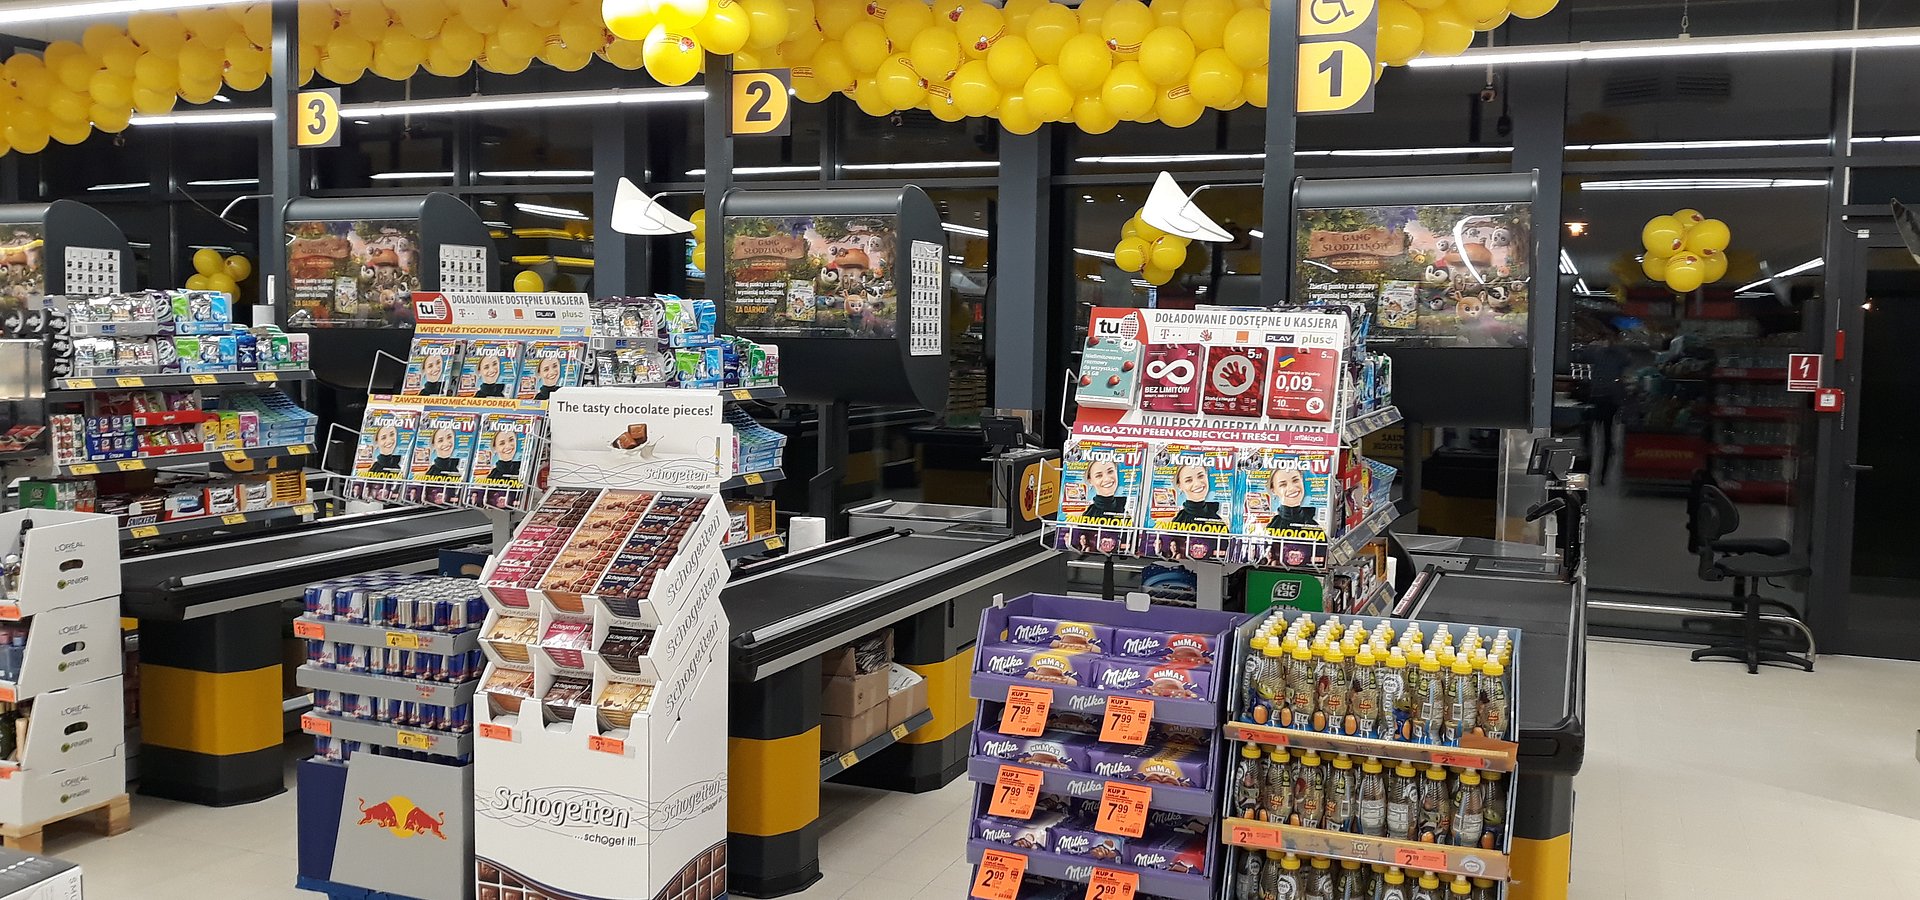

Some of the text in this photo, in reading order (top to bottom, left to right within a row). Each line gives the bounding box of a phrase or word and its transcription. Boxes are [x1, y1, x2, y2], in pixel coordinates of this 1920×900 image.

[1318, 49, 1342, 97] 1
[744, 80, 772, 122] 2
[307, 98, 326, 136] 3
[1342, 233, 1371, 242] GANG
[1322, 240, 1388, 252] SŁODZIAKÓW
[418, 302, 434, 315] tu
[452, 295, 585, 308] DOŁADOWANIE DOSTĘPNE U KASJERA
[562, 309, 577, 319] plus
[1155, 312, 1338, 329] DOŁADOWANIE DOSTĘPNE U KASJERA
[420, 326, 449, 335] WIĘCEJ
[449, 326, 460, 334] NIŻ
[460, 327, 502, 335] TYGODNIK
[503, 328, 555, 336] TELEWIZYJNY
[1098, 319, 1120, 334] tu
[1302, 334, 1325, 345] plus
[420, 345, 448, 356] Kropka
[476, 346, 505, 358] Kropka
[536, 348, 566, 360] Kropka
[1160, 386, 1190, 394] LIMITÓW
[1276, 374, 1312, 392] 0,09
[394, 396, 423, 404] ZAWSZE
[422, 397, 448, 406] WARTO
[448, 396, 466, 406] MIEĆ
[466, 398, 481, 406] NAS
[481, 399, 498, 407] POD
[557, 401, 714, 418] The tasty chocolate pieces!
[374, 417, 416, 428] Kropka TV
[430, 418, 474, 431] Kropka TV
[490, 420, 523, 434] Kropka
[1082, 424, 1280, 442] MAGAZYN PEŁEN KOBIECYCH TREŚCI
[1083, 450, 1142, 465] Kropka TV
[1171, 454, 1232, 468] Kropka TV
[1263, 456, 1330, 472] Kropka TV
[644, 468, 709, 484] Schogetten
[128, 516, 156, 526] SNICKERS
[1277, 590, 1296, 598] tac
[1281, 582, 1296, 591] tic
[550, 622, 581, 632] Schogetten
[1015, 624, 1050, 643] Milka
[1123, 638, 1160, 658] Milka
[988, 654, 1024, 675] Milka
[1102, 668, 1140, 690] Milka
[1069, 694, 1106, 712] Milka
[983, 740, 1018, 756] Milka
[1095, 761, 1133, 777] Milka
[1067, 780, 1104, 796] Milka
[490, 786, 630, 829] Schogetten
[662, 779, 722, 824] Schogetten
[1152, 812, 1182, 824] Milka
[982, 828, 1012, 844] Milka
[1058, 835, 1090, 852] Milka
[1352, 841, 1369, 850] TOY
[1134, 852, 1167, 869] Milka
